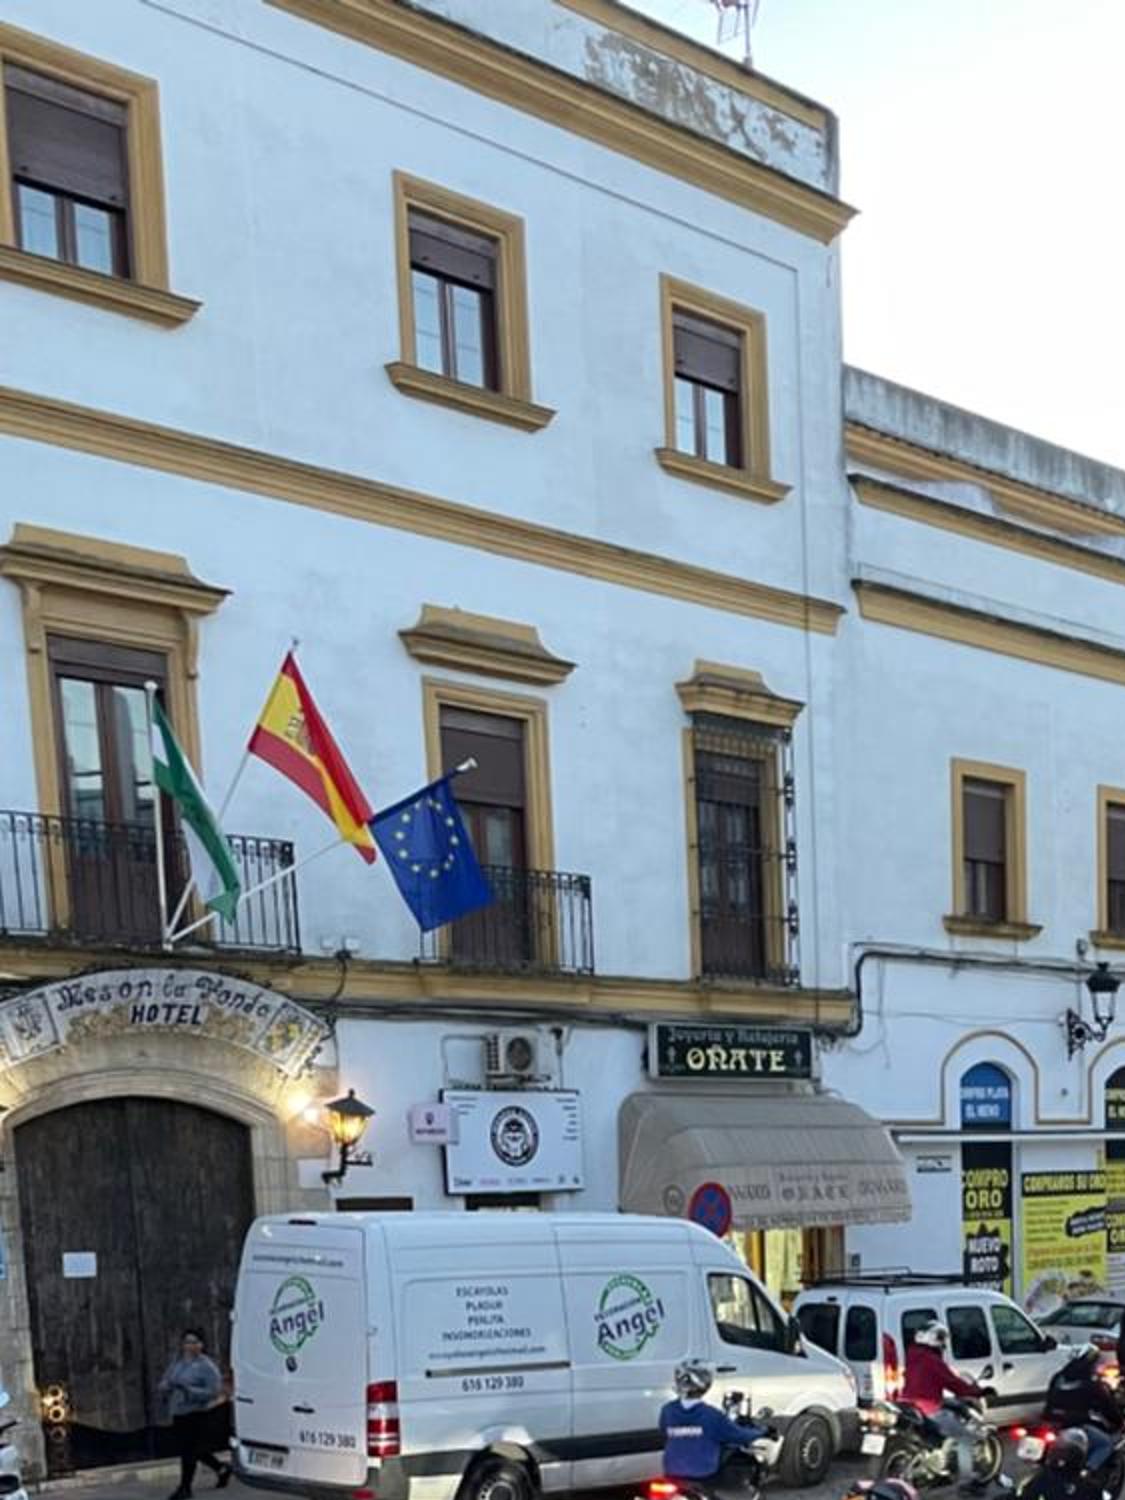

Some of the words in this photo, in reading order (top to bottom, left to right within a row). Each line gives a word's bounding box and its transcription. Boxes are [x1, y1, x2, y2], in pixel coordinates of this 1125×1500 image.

[131, 1003, 204, 1026] HOTEL
[686, 1044, 786, 1072] OÑATE
[966, 1190, 1002, 1208] ORO
[270, 1299, 324, 1335] Angel
[598, 1298, 665, 1345] Angel
